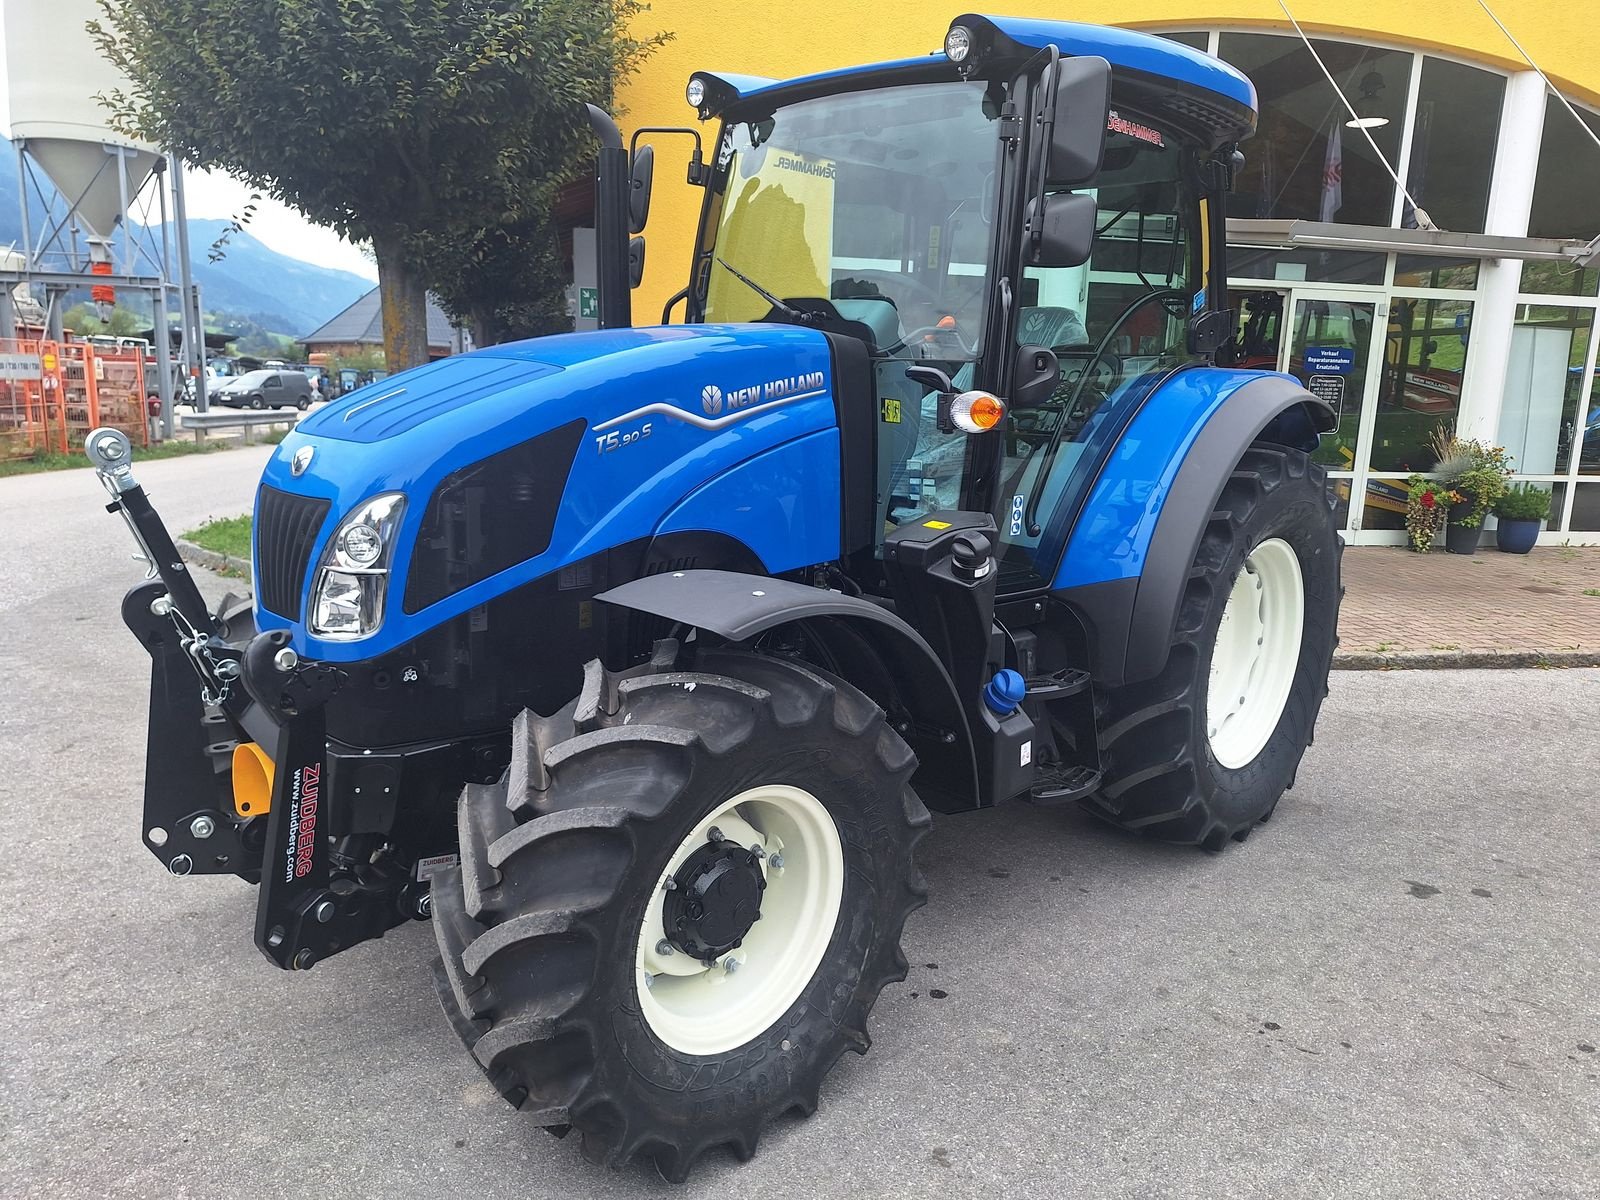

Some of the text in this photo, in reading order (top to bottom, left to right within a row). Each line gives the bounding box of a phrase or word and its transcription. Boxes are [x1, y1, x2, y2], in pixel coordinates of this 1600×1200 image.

[726, 371, 825, 410] NEW HOLLAND
[641, 423, 653, 438] S
[285, 768, 302, 883] www.zuidberg.com
[296, 762, 321, 878] ZUIDBERG
[422, 855, 455, 867] ZUIDBERG
